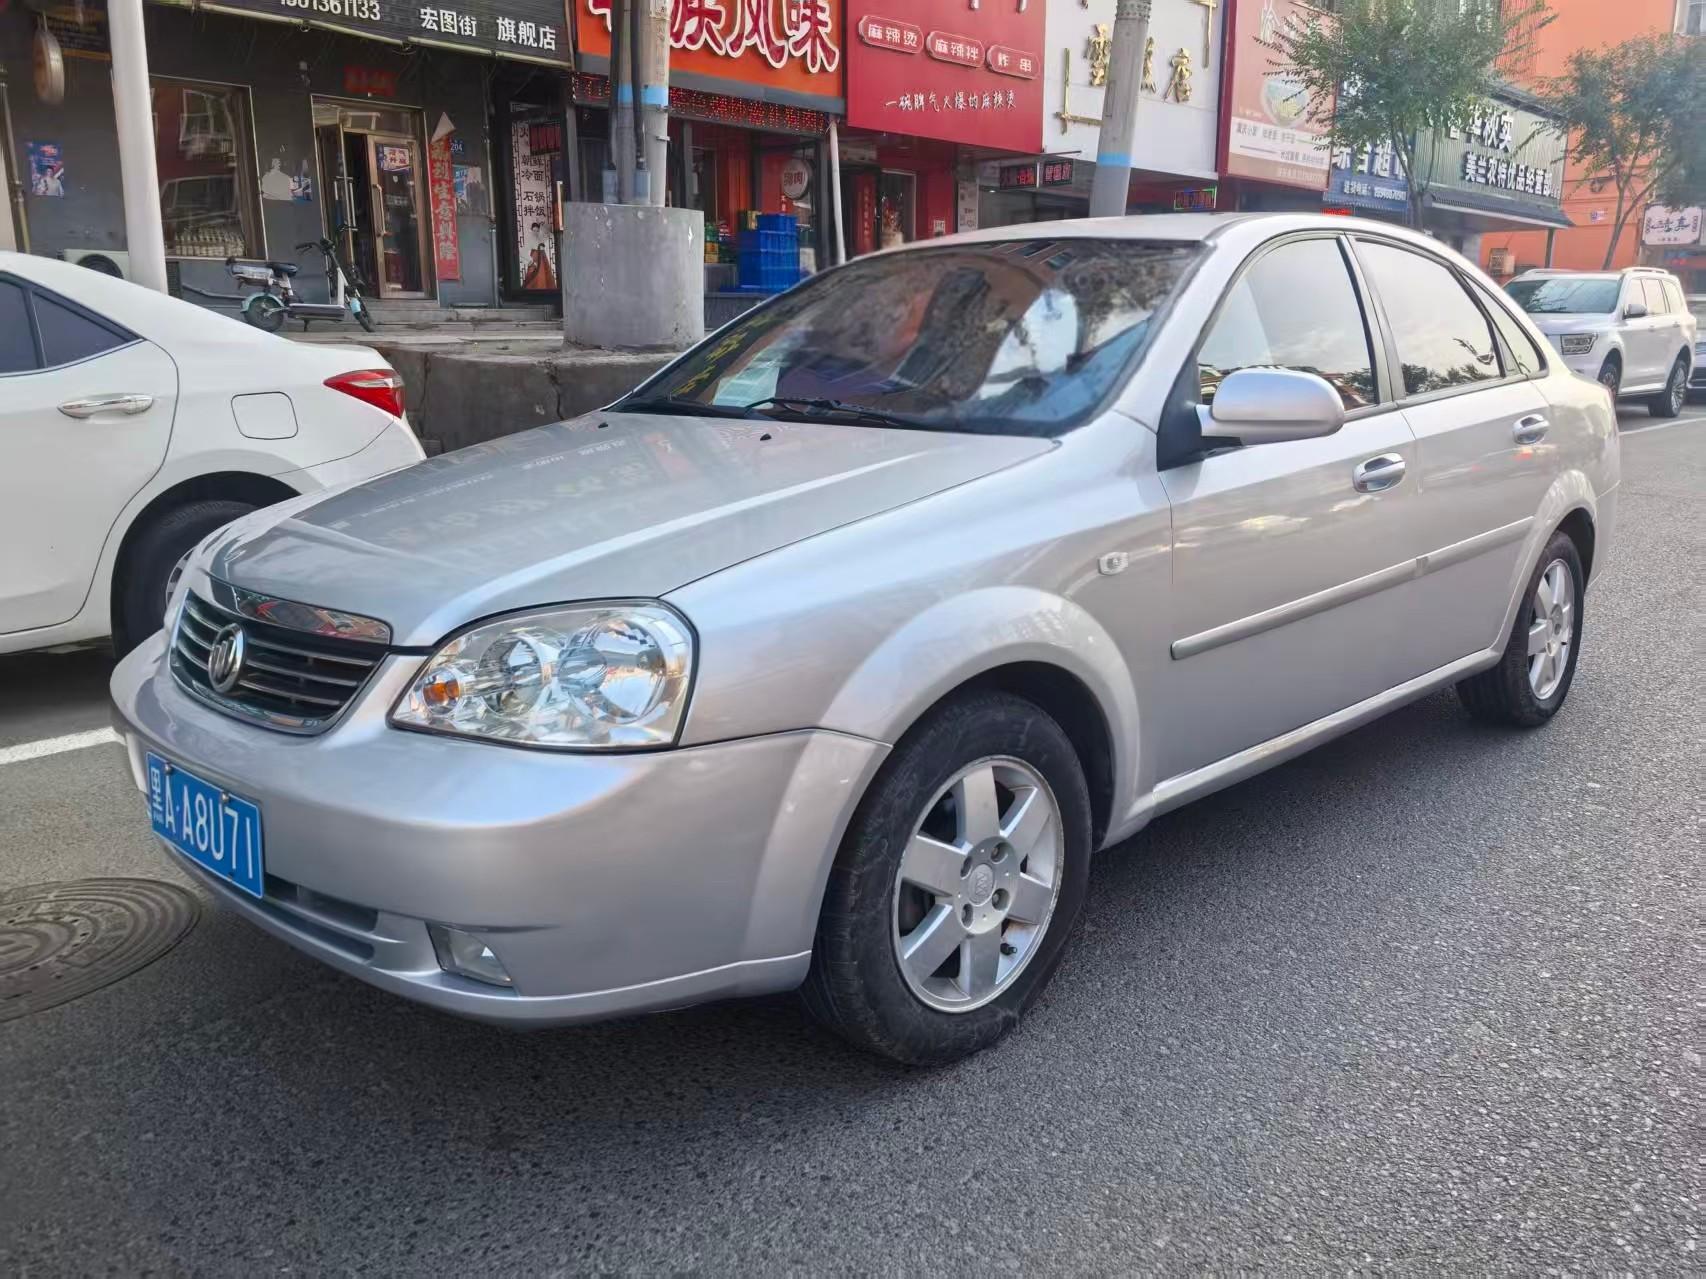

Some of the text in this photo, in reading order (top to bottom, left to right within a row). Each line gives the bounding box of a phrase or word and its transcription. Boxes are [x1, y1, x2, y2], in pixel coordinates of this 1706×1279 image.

[420, 7, 556, 51] 宏图街 旗舰店
[868, 23, 918, 48] 麻辣烫
[934, 38, 979, 61] 麻辣拌
[522, 170, 544, 182] 冷面
[523, 191, 545, 202] 石锅
[524, 205, 546, 217] 拌饭
